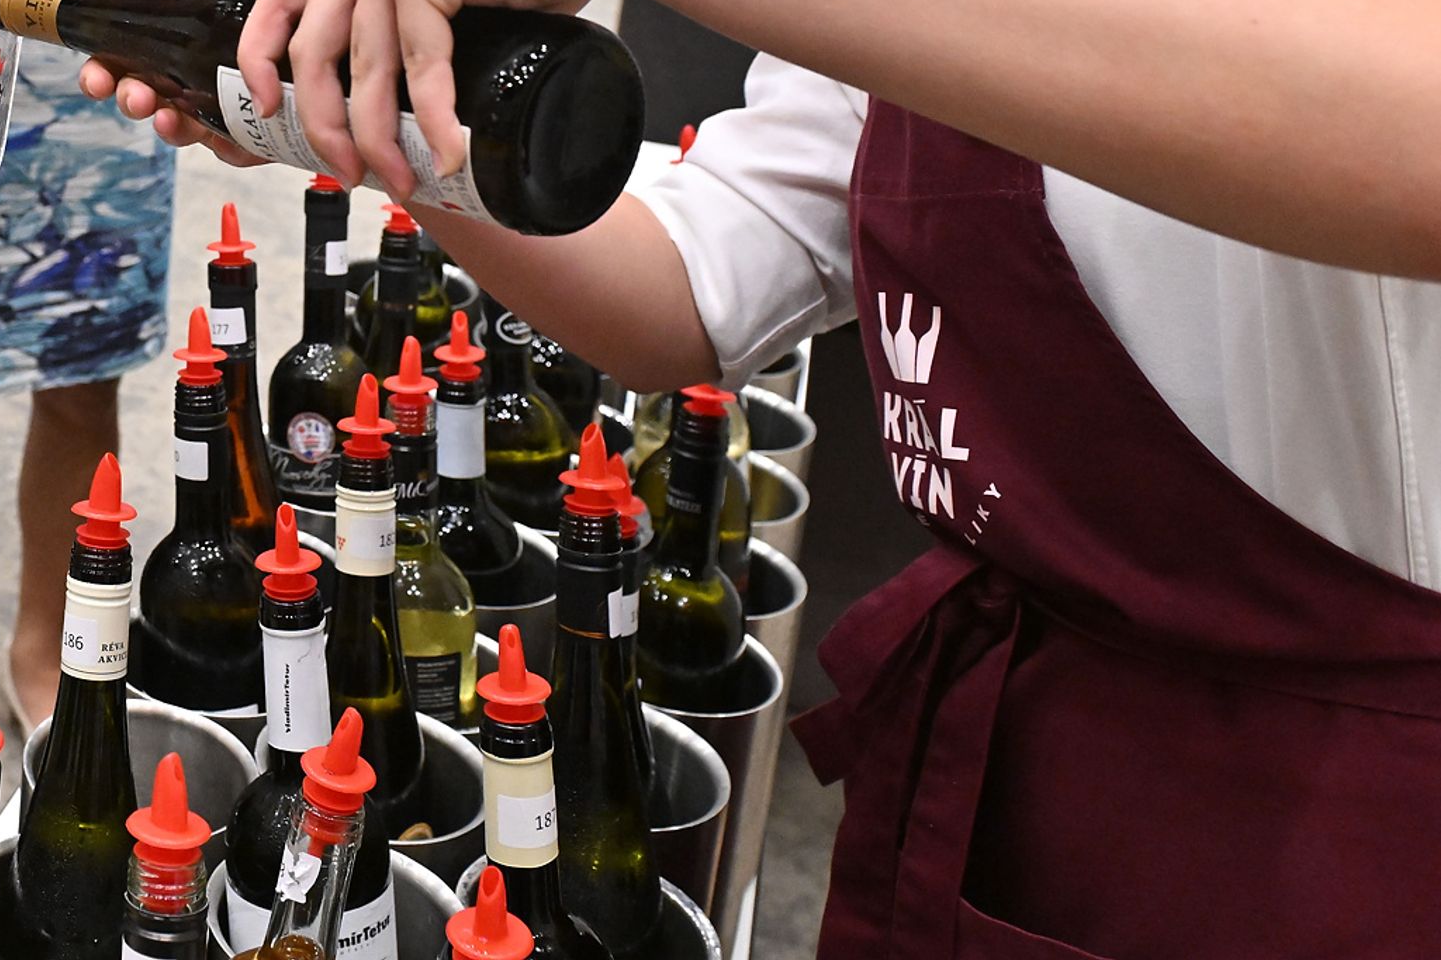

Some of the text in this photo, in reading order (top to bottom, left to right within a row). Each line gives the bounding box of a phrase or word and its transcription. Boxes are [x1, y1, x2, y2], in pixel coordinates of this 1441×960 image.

[964, 482, 1002, 546] LIKY
[64, 631, 84, 650] 186
[97, 651, 127, 663] AKVIC
